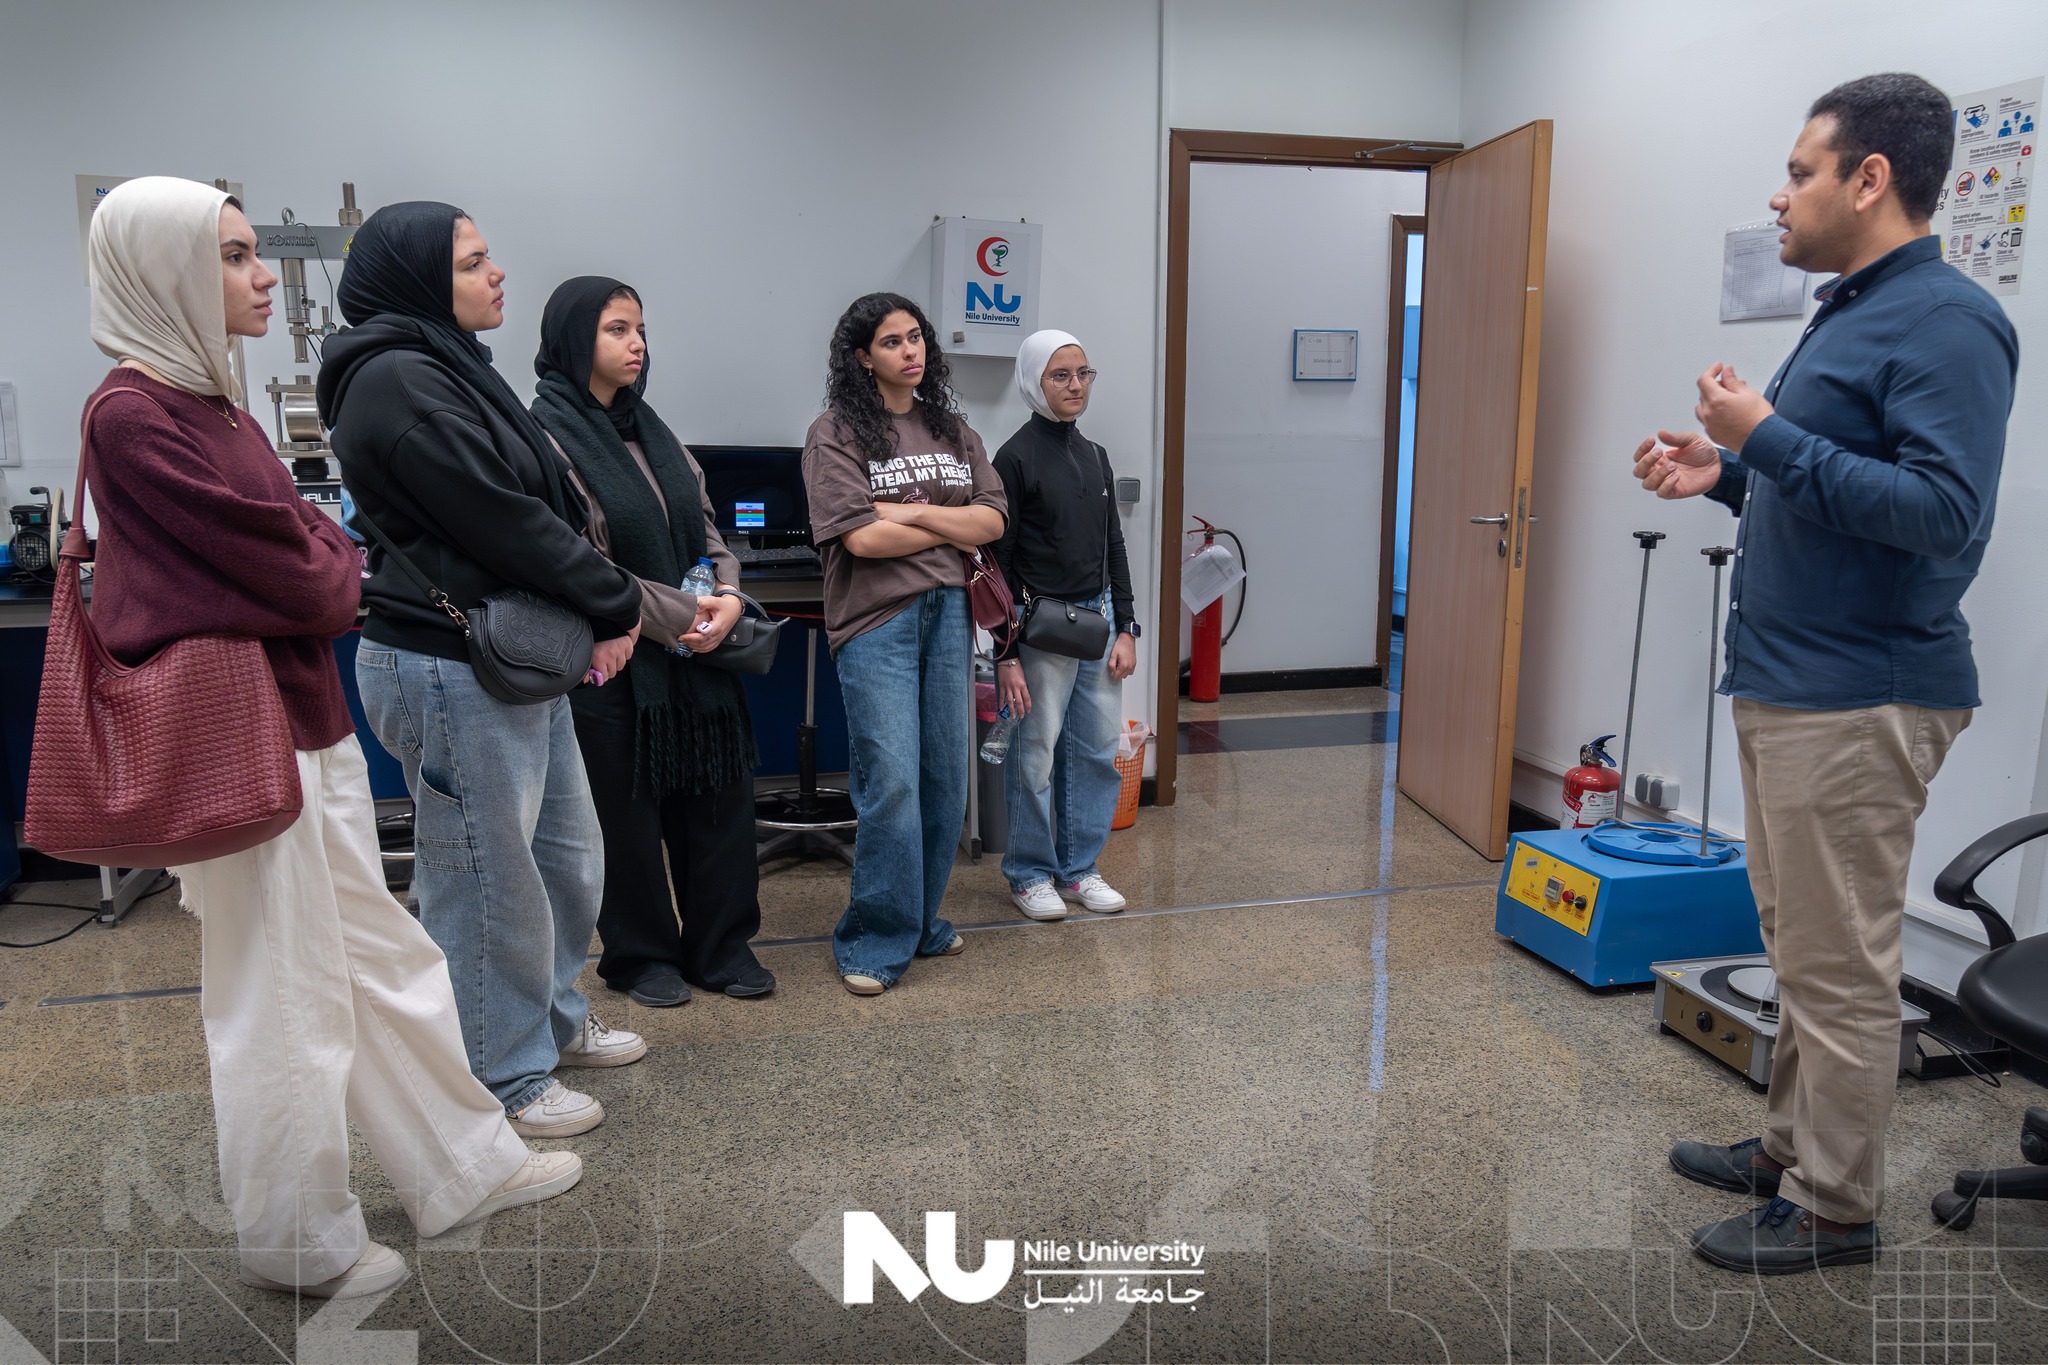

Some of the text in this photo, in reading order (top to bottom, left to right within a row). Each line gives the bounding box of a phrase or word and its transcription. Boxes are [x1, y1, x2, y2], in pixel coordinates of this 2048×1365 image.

[966, 281, 1021, 314] NU
[965, 312, 1020, 324] Nile University
[905, 454, 936, 468] THE
[914, 466, 937, 482] MY
[939, 464, 972, 480] HEART
[889, 487, 900, 495] NO.
